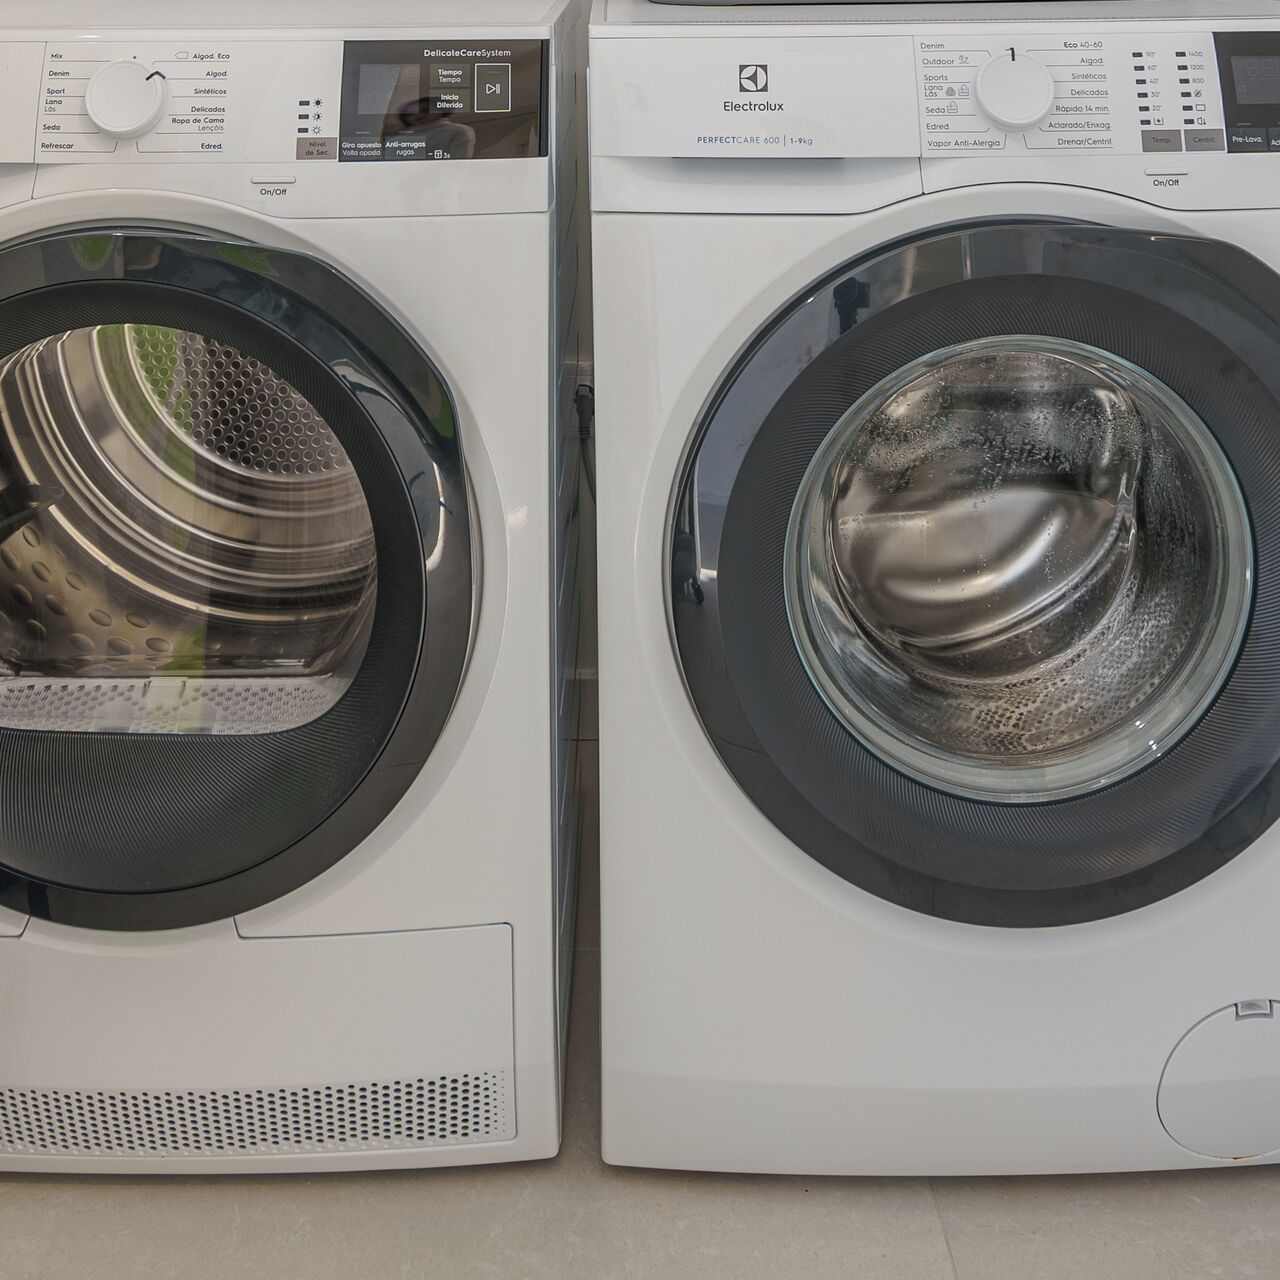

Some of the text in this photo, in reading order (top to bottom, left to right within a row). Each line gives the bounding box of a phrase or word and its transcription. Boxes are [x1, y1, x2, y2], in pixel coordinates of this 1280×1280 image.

[920, 42, 945, 50] Denim
[423, 49, 511, 58] DelicateCareSystem
[438, 69, 463, 77] Tiempo
[439, 76, 461, 84] Tempo
[923, 74, 948, 82] Sports
[436, 101, 464, 109] Diferido
[723, 101, 784, 112] Electrolux
[385, 141, 426, 149] Anti-arrugas
[697, 136, 813, 146] PERFECTCARE 600 1-9kg
[954, 140, 1001, 148] Anti-Alergia
[357, 142, 382, 150] opuesto
[396, 149, 415, 157] rugas
[1153, 179, 1179, 187] On/Off
[260, 188, 287, 196] On/Off
